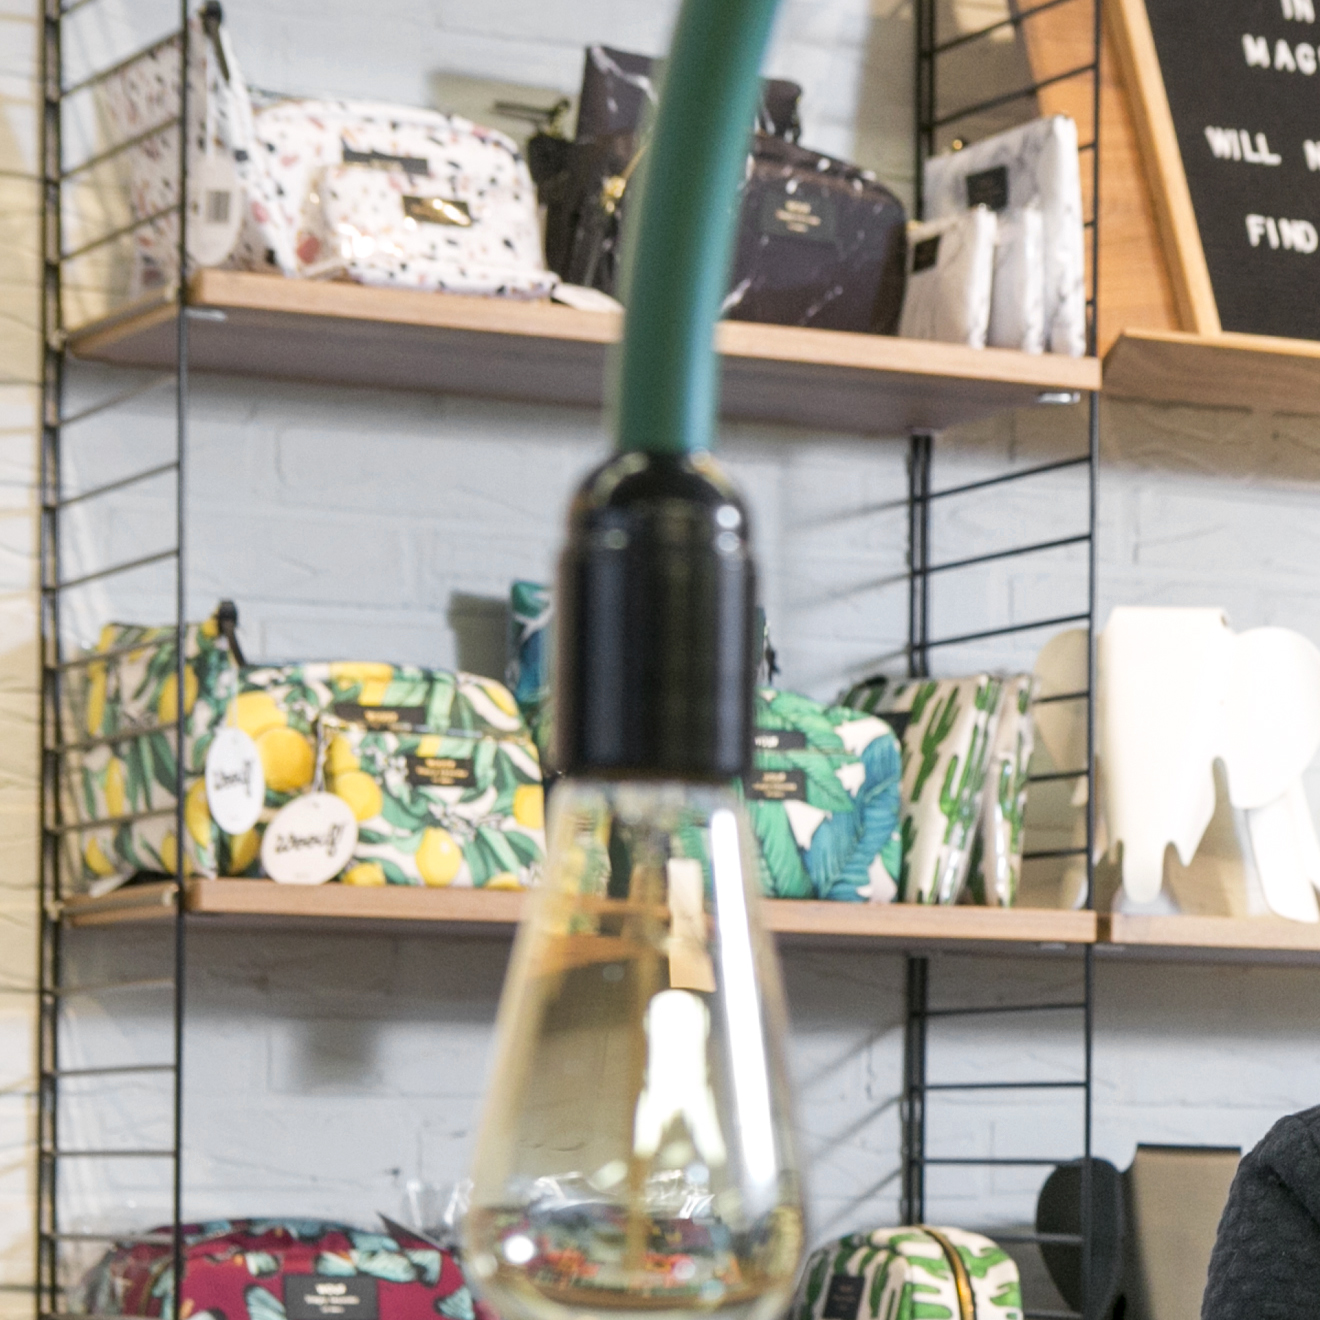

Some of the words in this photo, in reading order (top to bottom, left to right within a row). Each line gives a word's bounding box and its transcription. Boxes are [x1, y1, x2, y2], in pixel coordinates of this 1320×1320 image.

[1280, 0, 1316, 23] IN
[1204, 125, 1282, 166] WILL
[1245, 214, 1319, 254] FIND
